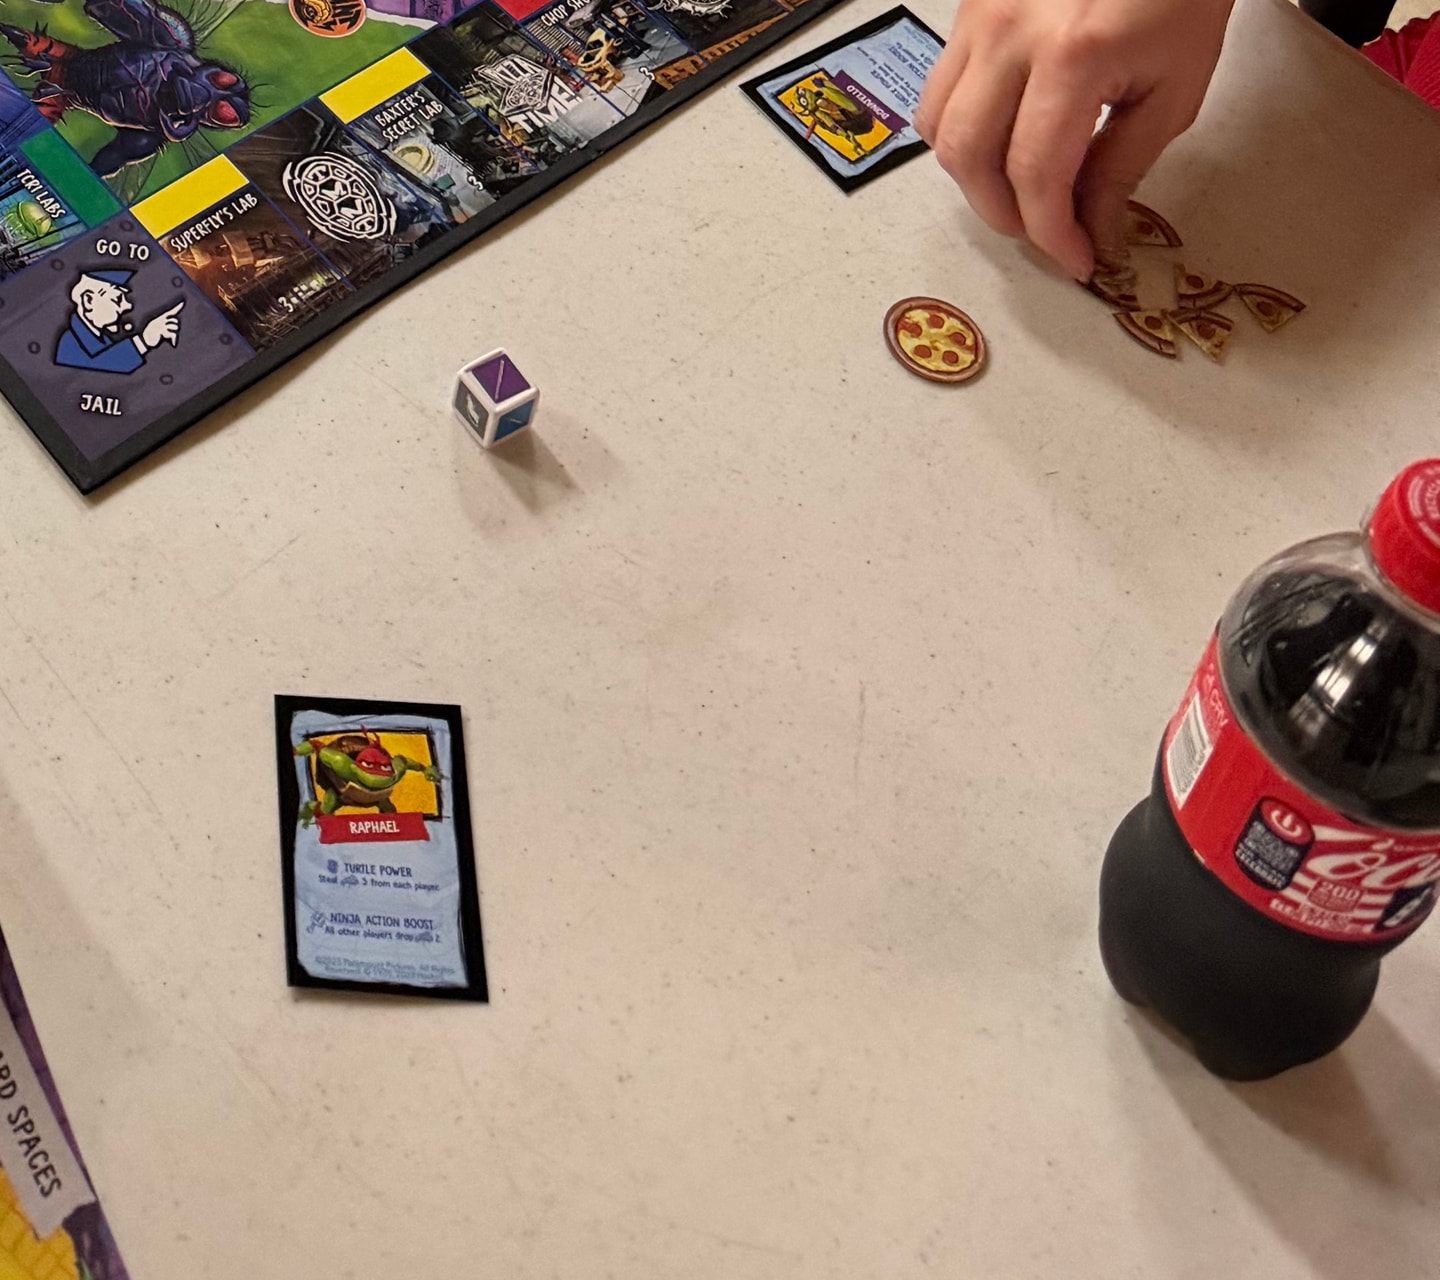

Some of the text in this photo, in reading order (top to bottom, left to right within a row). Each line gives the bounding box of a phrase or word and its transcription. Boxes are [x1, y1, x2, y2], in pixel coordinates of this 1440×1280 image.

[540, 2, 570, 29] CHOP
[638, 62, 657, 84] 3
[374, 91, 425, 127] BAXTER'S
[842, 82, 893, 121] DONATELLO
[382, 100, 443, 142] SECRET LAB
[466, 171, 485, 193] 3
[15, 167, 67, 221] TCRI LABS
[168, 189, 260, 253] SUPERFLY'S LAB
[95, 238, 149, 261] GO TO
[276, 292, 297, 316] 3
[79, 392, 123, 418] JAIL
[349, 820, 400, 834] RAPHAEL
[343, 862, 413, 877] TURTLE POWER
[370, 879, 391, 888] from
[393, 881, 412, 889] each
[1319, 882, 1360, 901] 200
[330, 912, 434, 931] NINJA ACTION BOOST
[338, 928, 360, 937] other
[363, 930, 393, 940] players
[7, 1104, 62, 1200] SPACES
